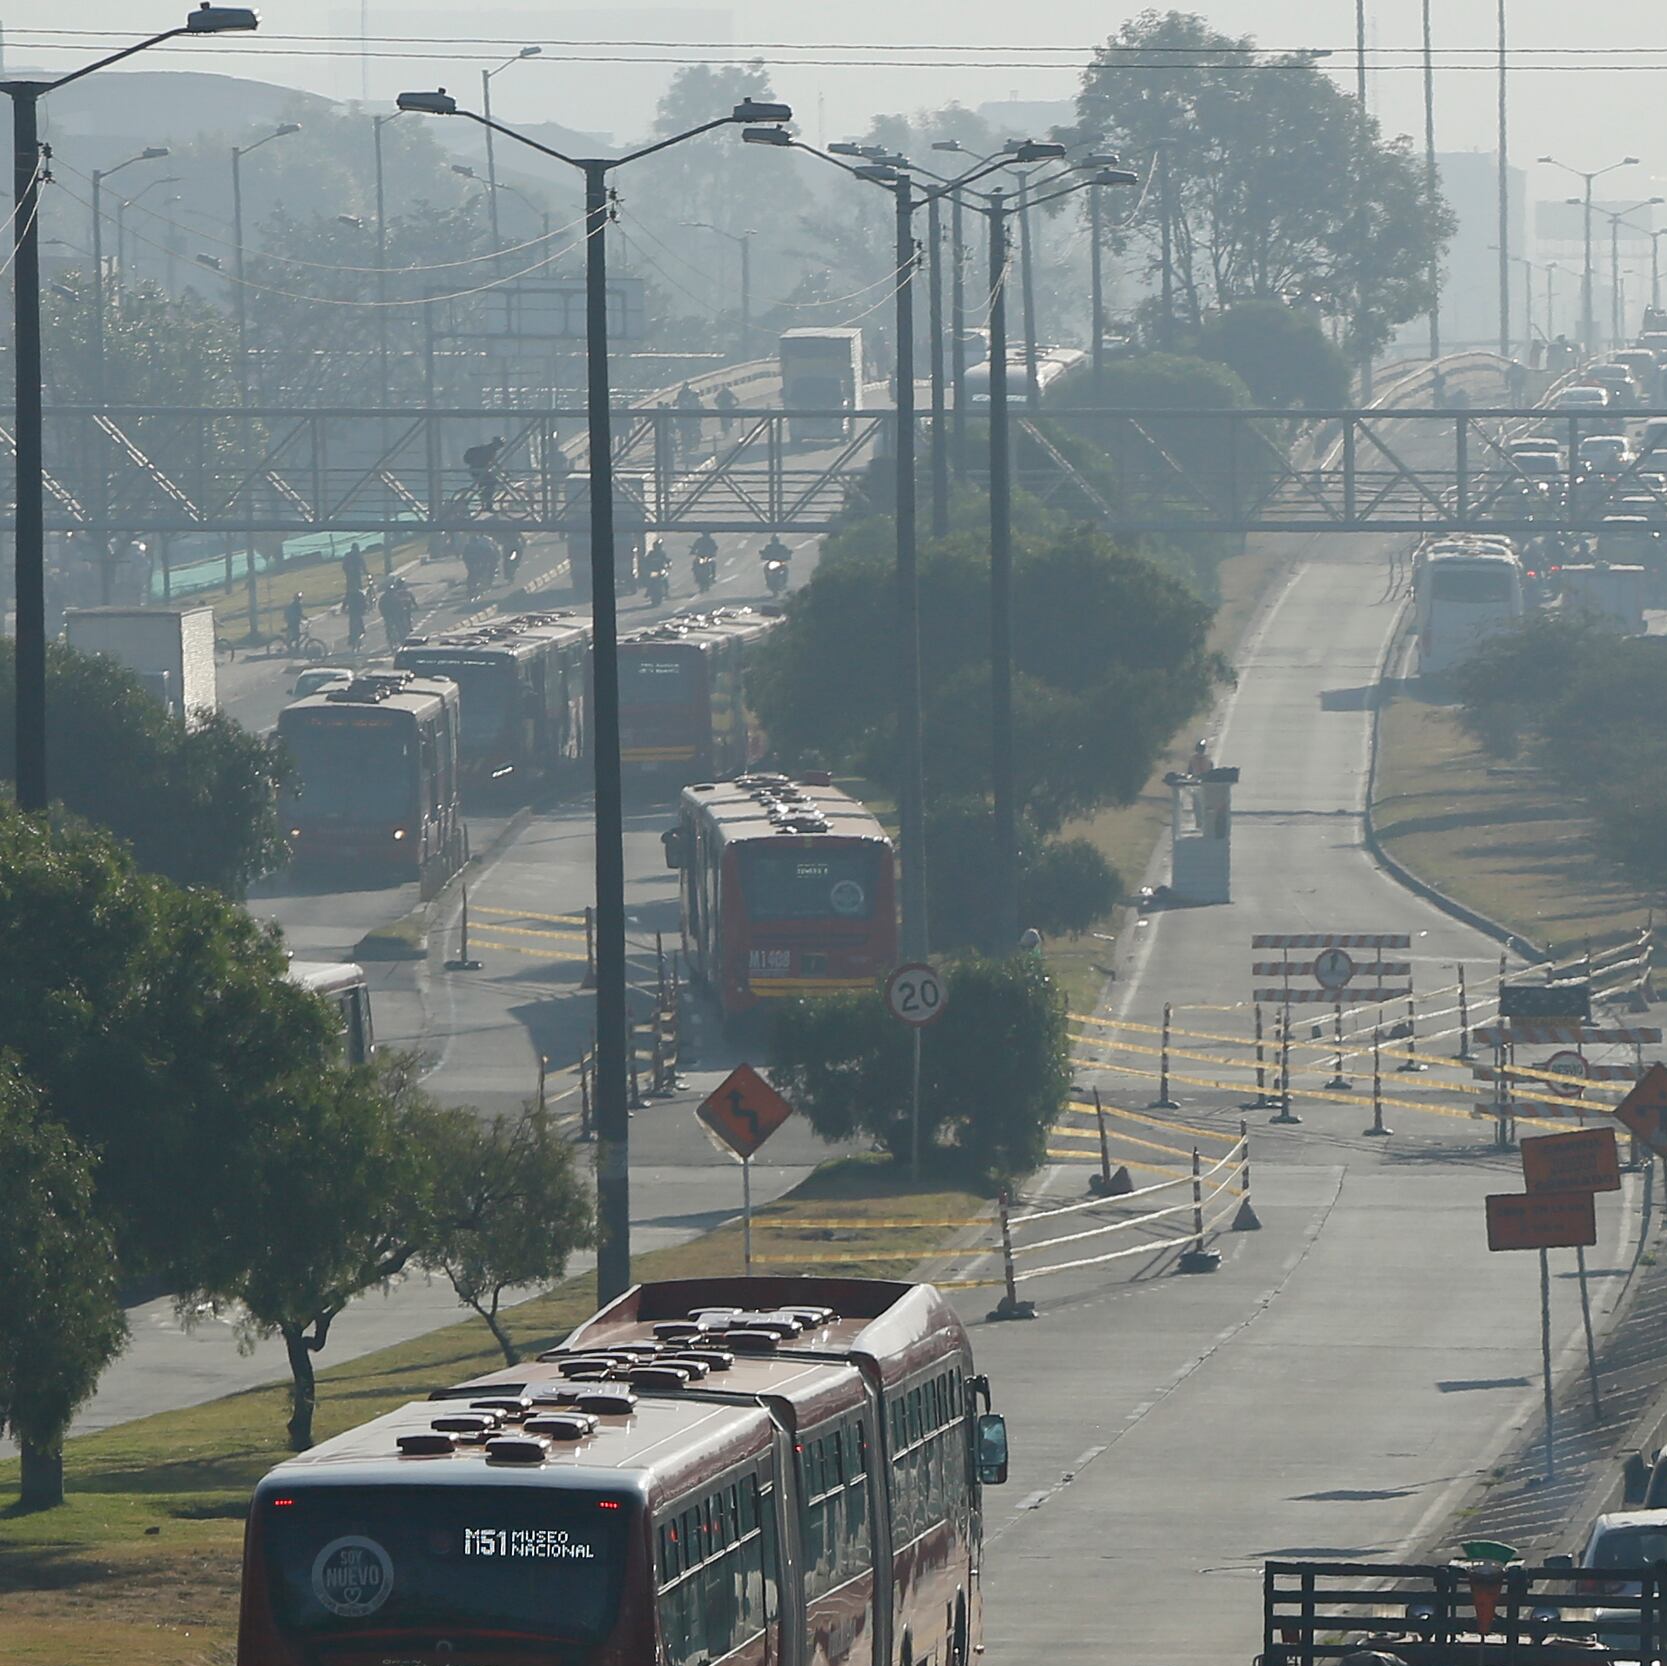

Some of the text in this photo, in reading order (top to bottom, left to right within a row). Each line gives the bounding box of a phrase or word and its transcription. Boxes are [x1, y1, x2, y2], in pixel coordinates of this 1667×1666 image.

[899, 979, 939, 1011] 20
[465, 1529, 508, 1557] M51
[512, 1531, 569, 1545] MUSEO
[340, 1550, 364, 1565] SOY
[512, 1543, 595, 1559] NACIONAL
[326, 1566, 380, 1588] NUEVO
